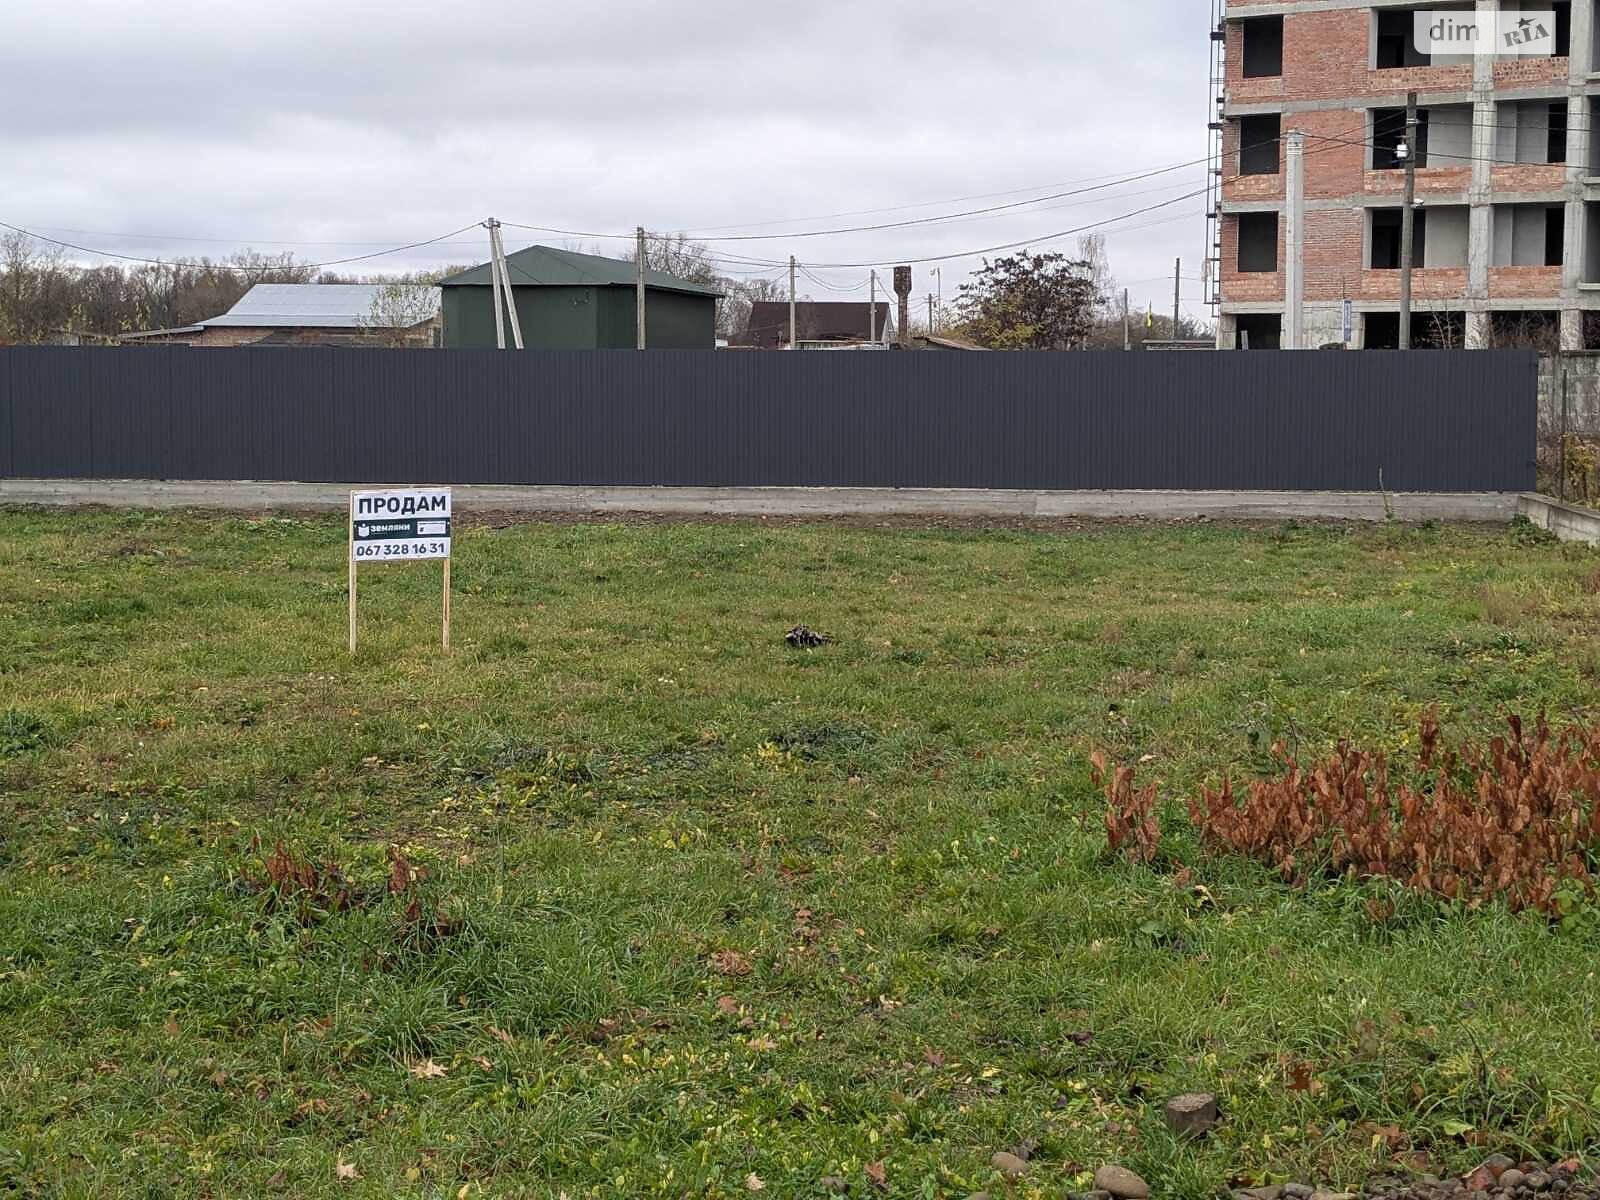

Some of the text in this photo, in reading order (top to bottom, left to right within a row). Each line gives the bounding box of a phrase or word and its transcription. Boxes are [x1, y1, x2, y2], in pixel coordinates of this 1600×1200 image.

[358, 495, 446, 515] ПРОДАМ
[356, 543, 445, 556] 067 328 16 31
